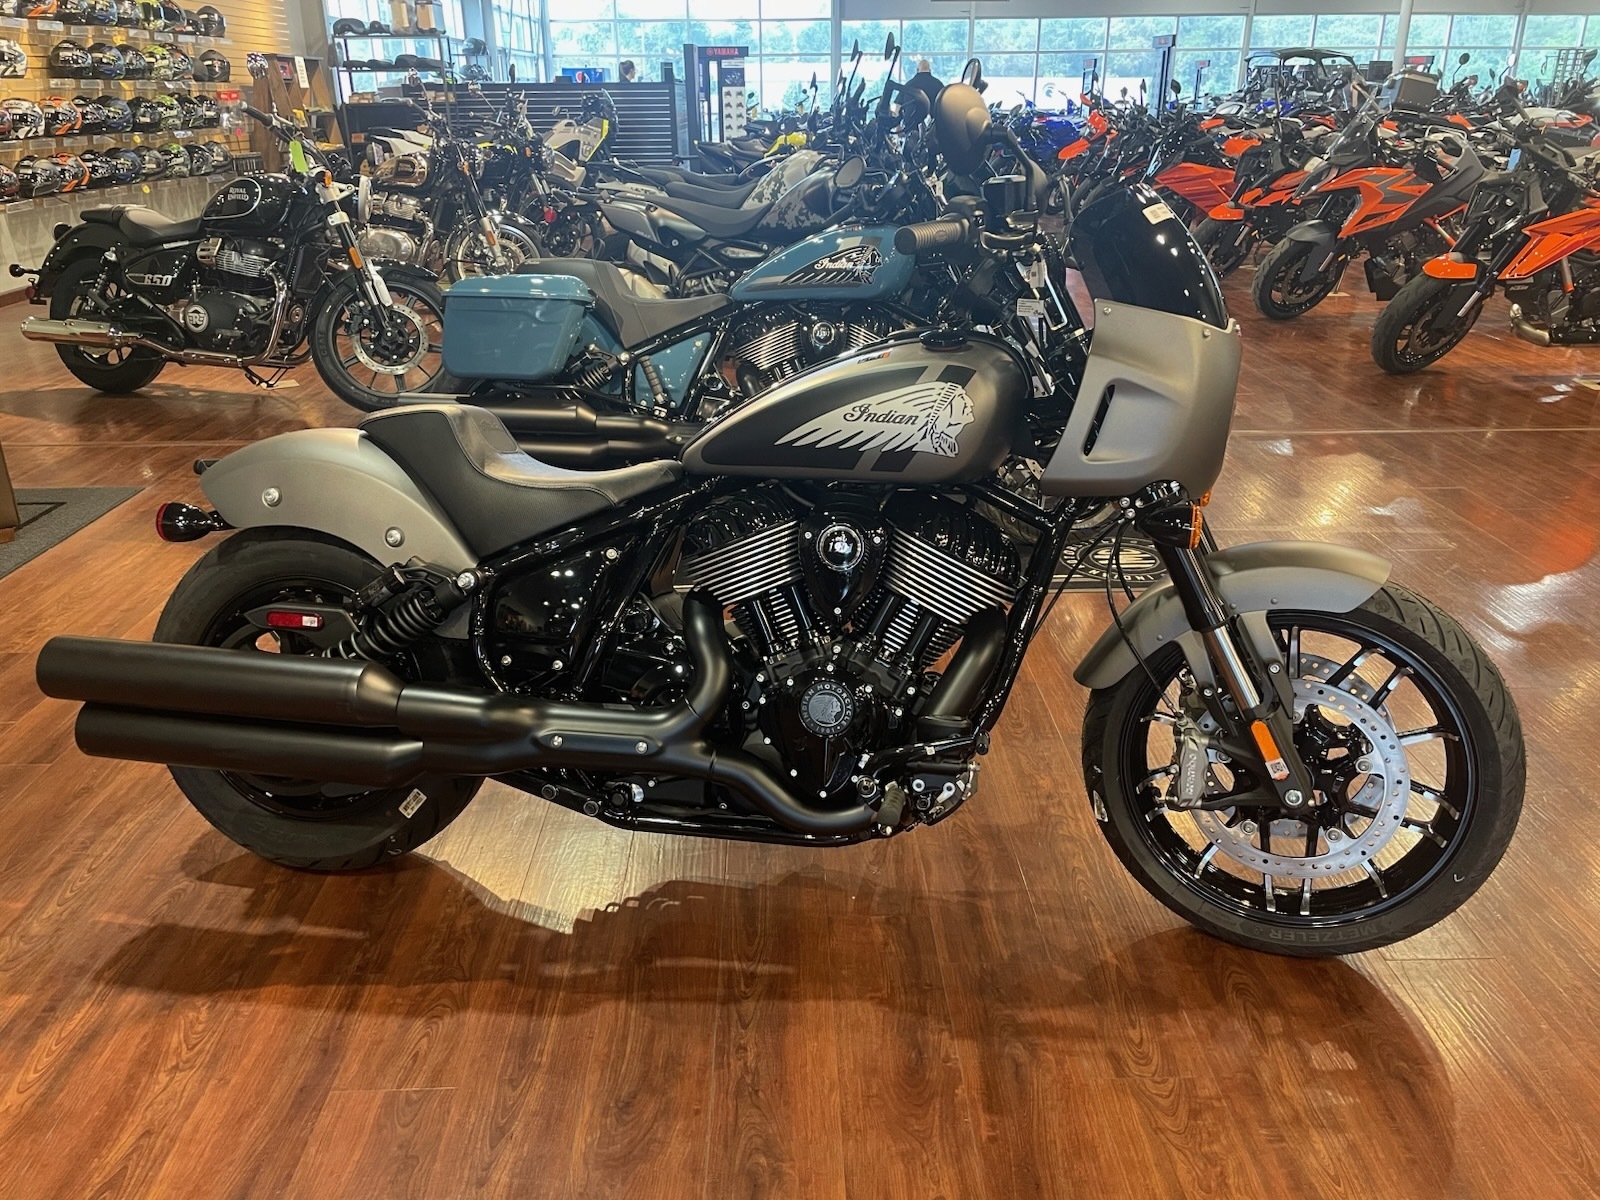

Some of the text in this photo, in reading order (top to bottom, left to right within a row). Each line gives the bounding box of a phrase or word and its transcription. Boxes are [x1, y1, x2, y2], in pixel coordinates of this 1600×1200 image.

[814, 258, 855, 270] Indian
[144, 274, 172, 286] 650
[843, 403, 919, 425] Indian
[801, 689, 815, 722] INDIAN
[817, 683, 852, 726] MOTORCYCLE
[1185, 753, 1197, 795] brembo
[1269, 923, 1379, 943] METZELER
